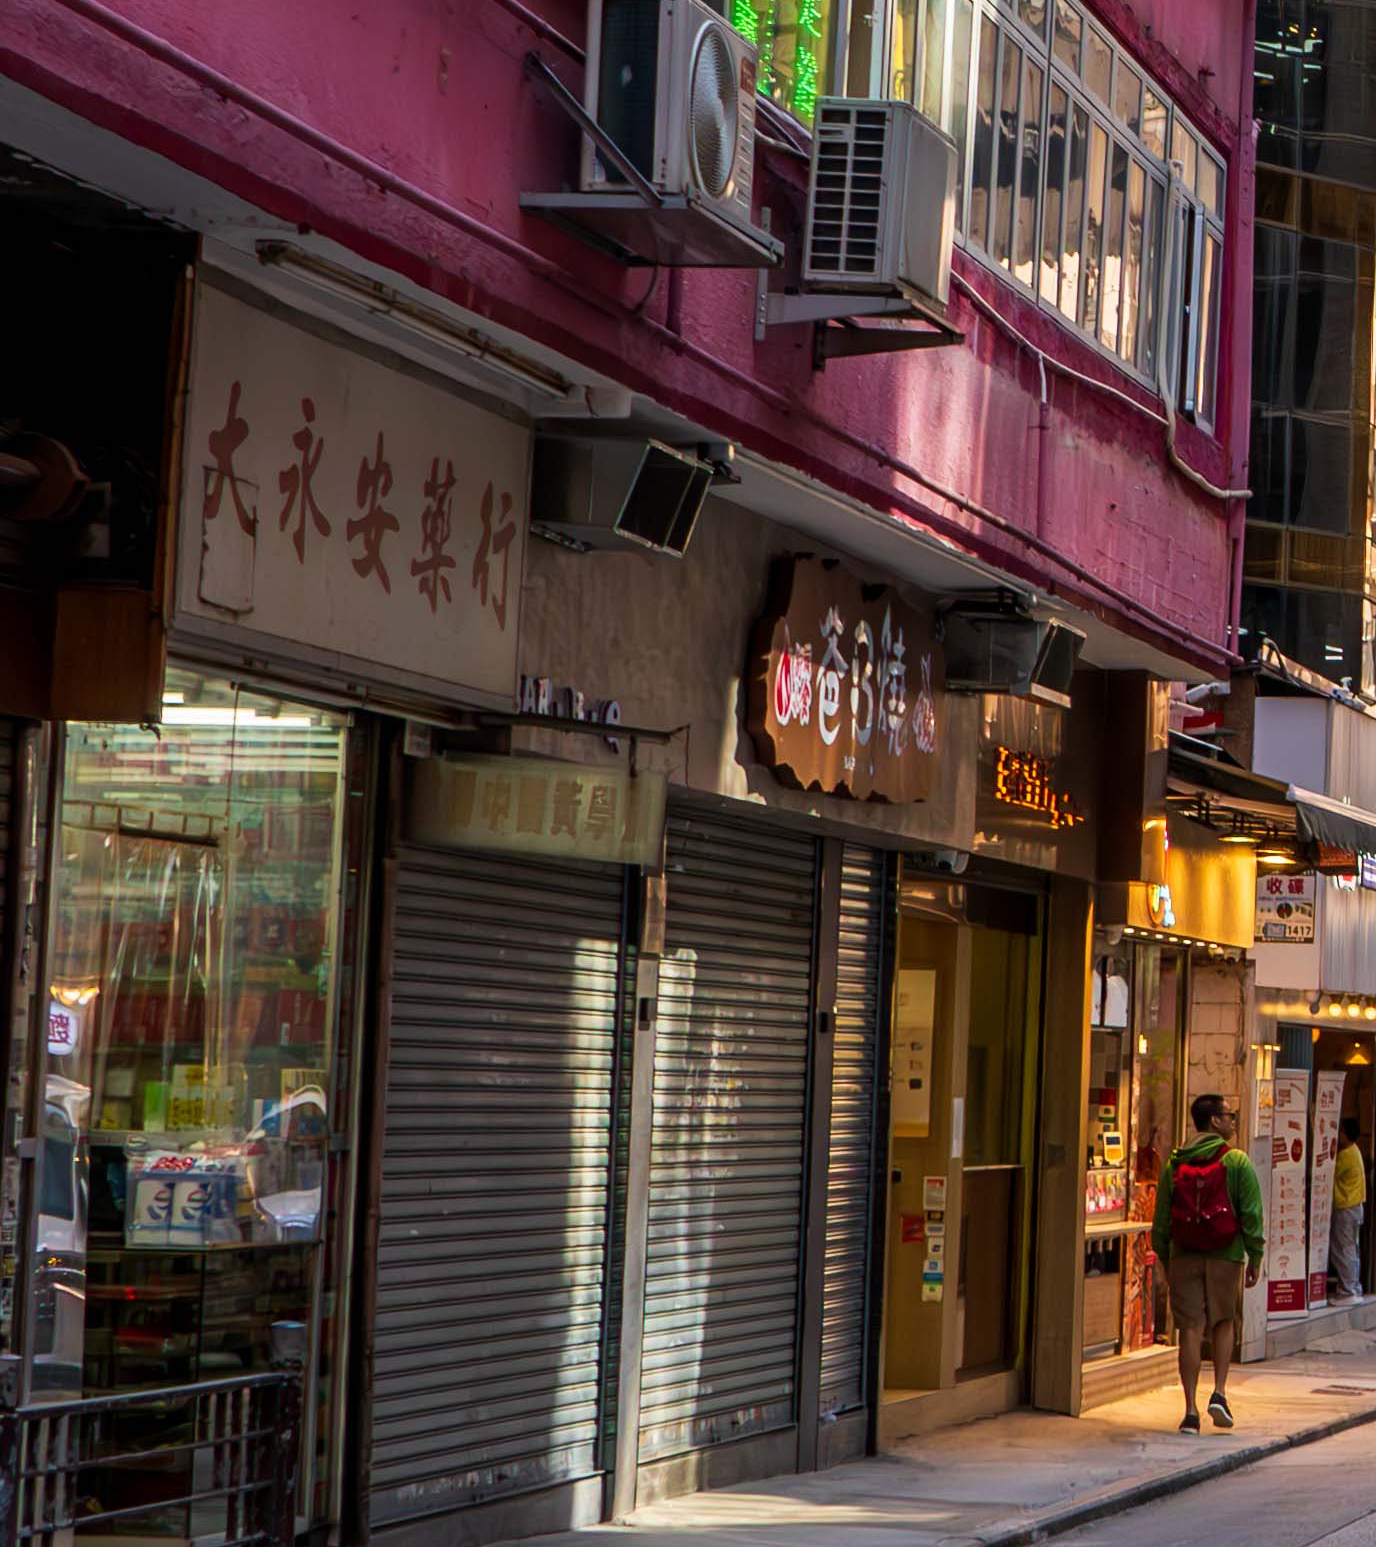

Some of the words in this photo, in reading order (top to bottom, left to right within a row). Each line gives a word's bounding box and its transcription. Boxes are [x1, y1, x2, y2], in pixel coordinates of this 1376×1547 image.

[205, 380, 516, 632] 大永安藥行
